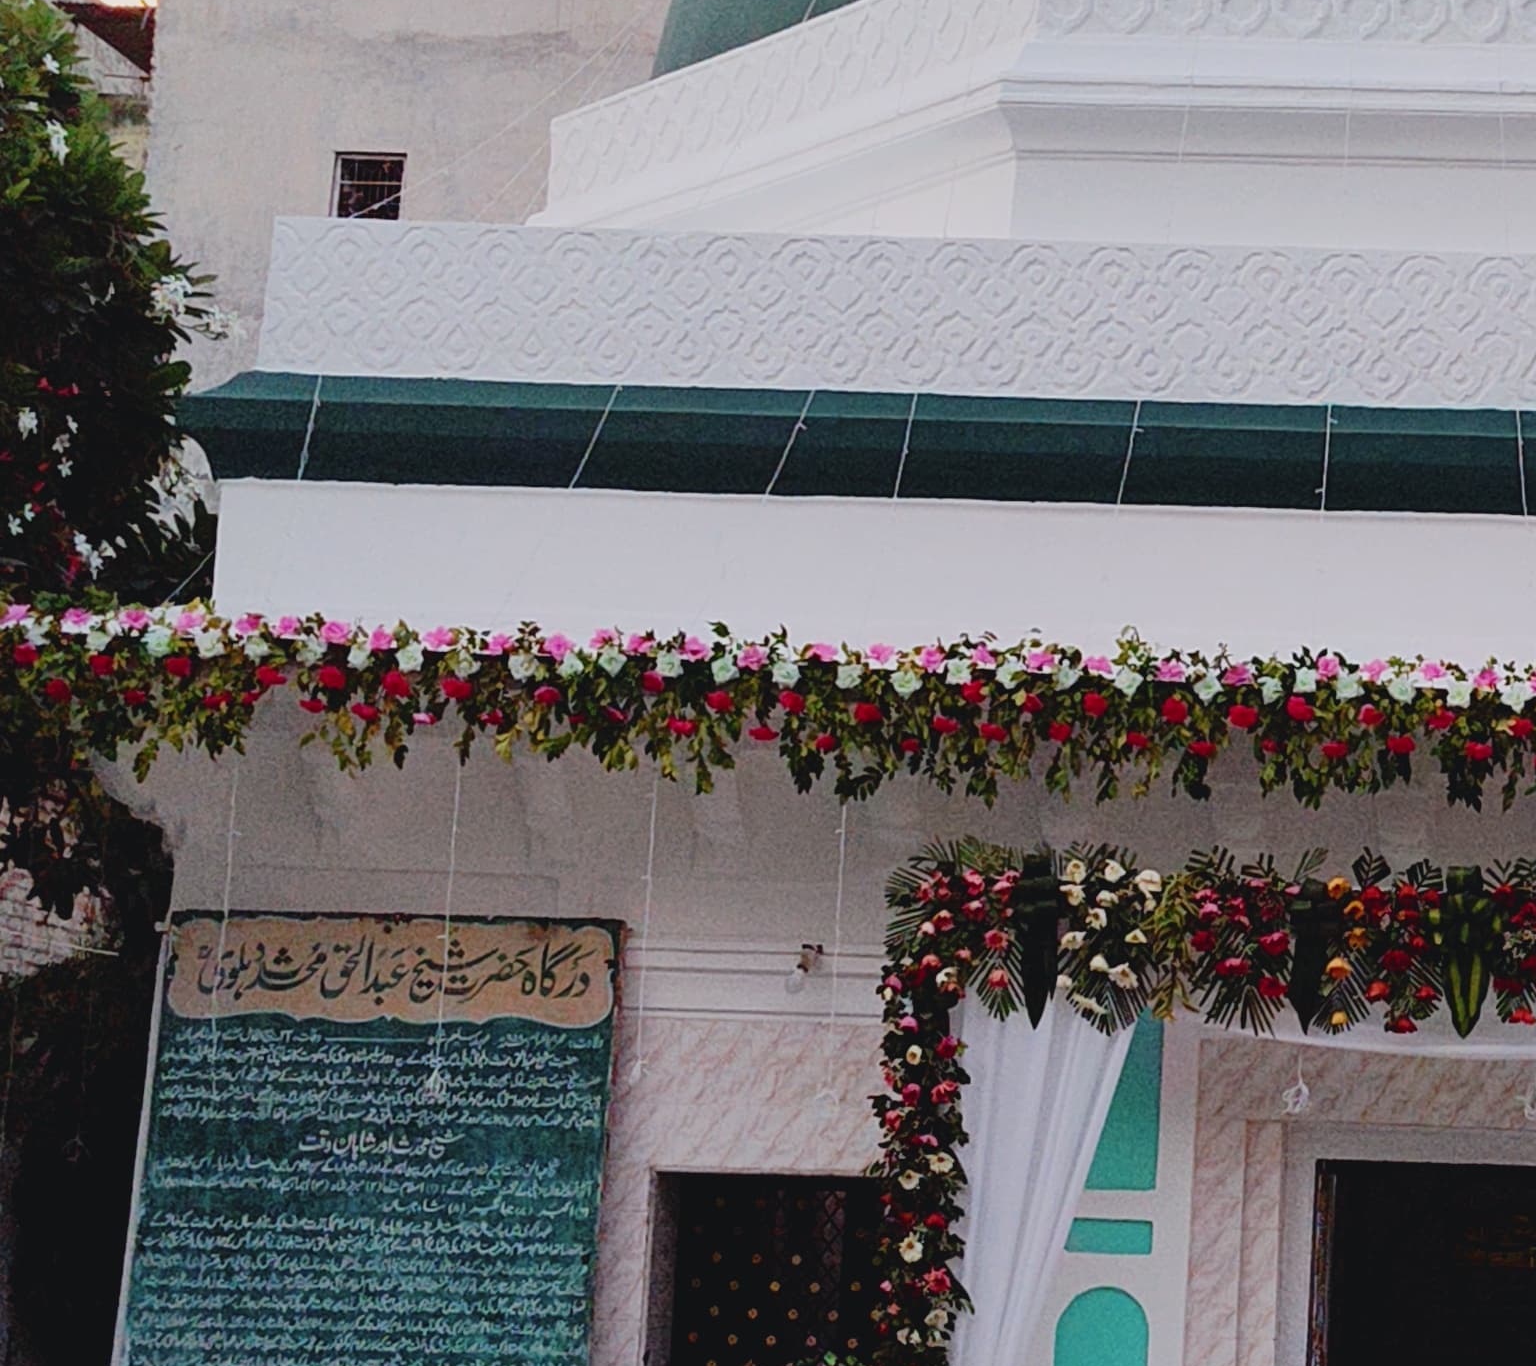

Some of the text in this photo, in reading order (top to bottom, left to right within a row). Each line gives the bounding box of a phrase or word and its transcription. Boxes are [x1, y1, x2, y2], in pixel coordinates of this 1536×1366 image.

[409, 939, 499, 1004] شیخ
[443, 946, 532, 1003] حضرت
[521, 941, 594, 998] درگاہ
